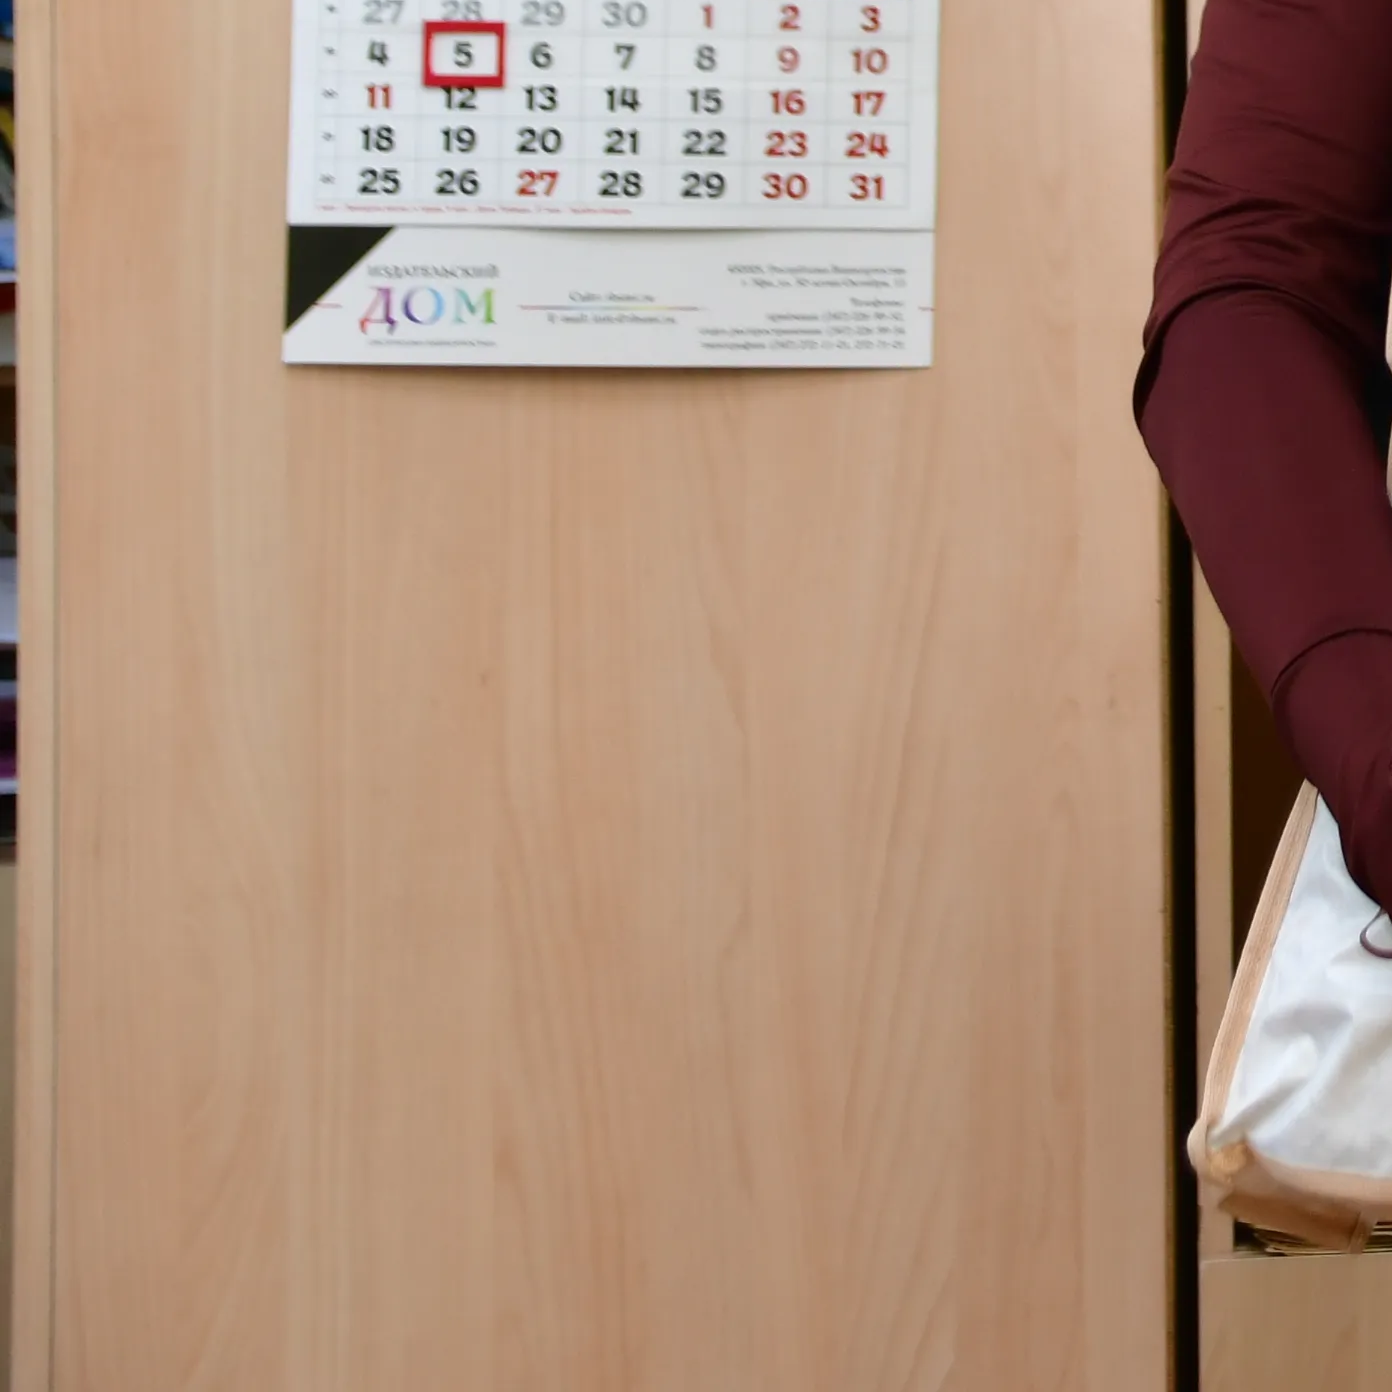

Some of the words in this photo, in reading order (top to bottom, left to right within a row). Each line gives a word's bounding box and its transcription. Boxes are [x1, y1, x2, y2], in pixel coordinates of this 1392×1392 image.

[701, 4, 714, 29] 1
[779, 4, 801, 31] 2
[860, 6, 881, 33] 3
[367, 41, 389, 67] 4
[453, 43, 474, 69] 5
[530, 42, 553, 70] 6
[614, 43, 637, 70] 7
[695, 44, 717, 72] 8
[776, 46, 800, 74] 9
[851, 48, 888, 75] 10
[366, 84, 391, 109] 11
[524, 86, 558, 112] 13
[605, 87, 641, 112] 14
[688, 88, 723, 115] 15
[770, 90, 806, 115] 16
[852, 91, 886, 116] 17
[361, 126, 395, 152] 18
[441, 126, 476, 153] 19
[517, 127, 562, 154] 20
[604, 129, 639, 155] 21
[682, 130, 726, 156] 22
[764, 131, 808, 158] 23
[845, 132, 889, 158] 24
[358, 168, 400, 195] 25
[435, 169, 479, 196] 26
[516, 170, 559, 196] 27
[598, 171, 642, 198] 28
[681, 172, 726, 199] 29
[763, 173, 808, 200] 30
[850, 174, 883, 200] 31
[359, 285, 496, 335] ДОМ
